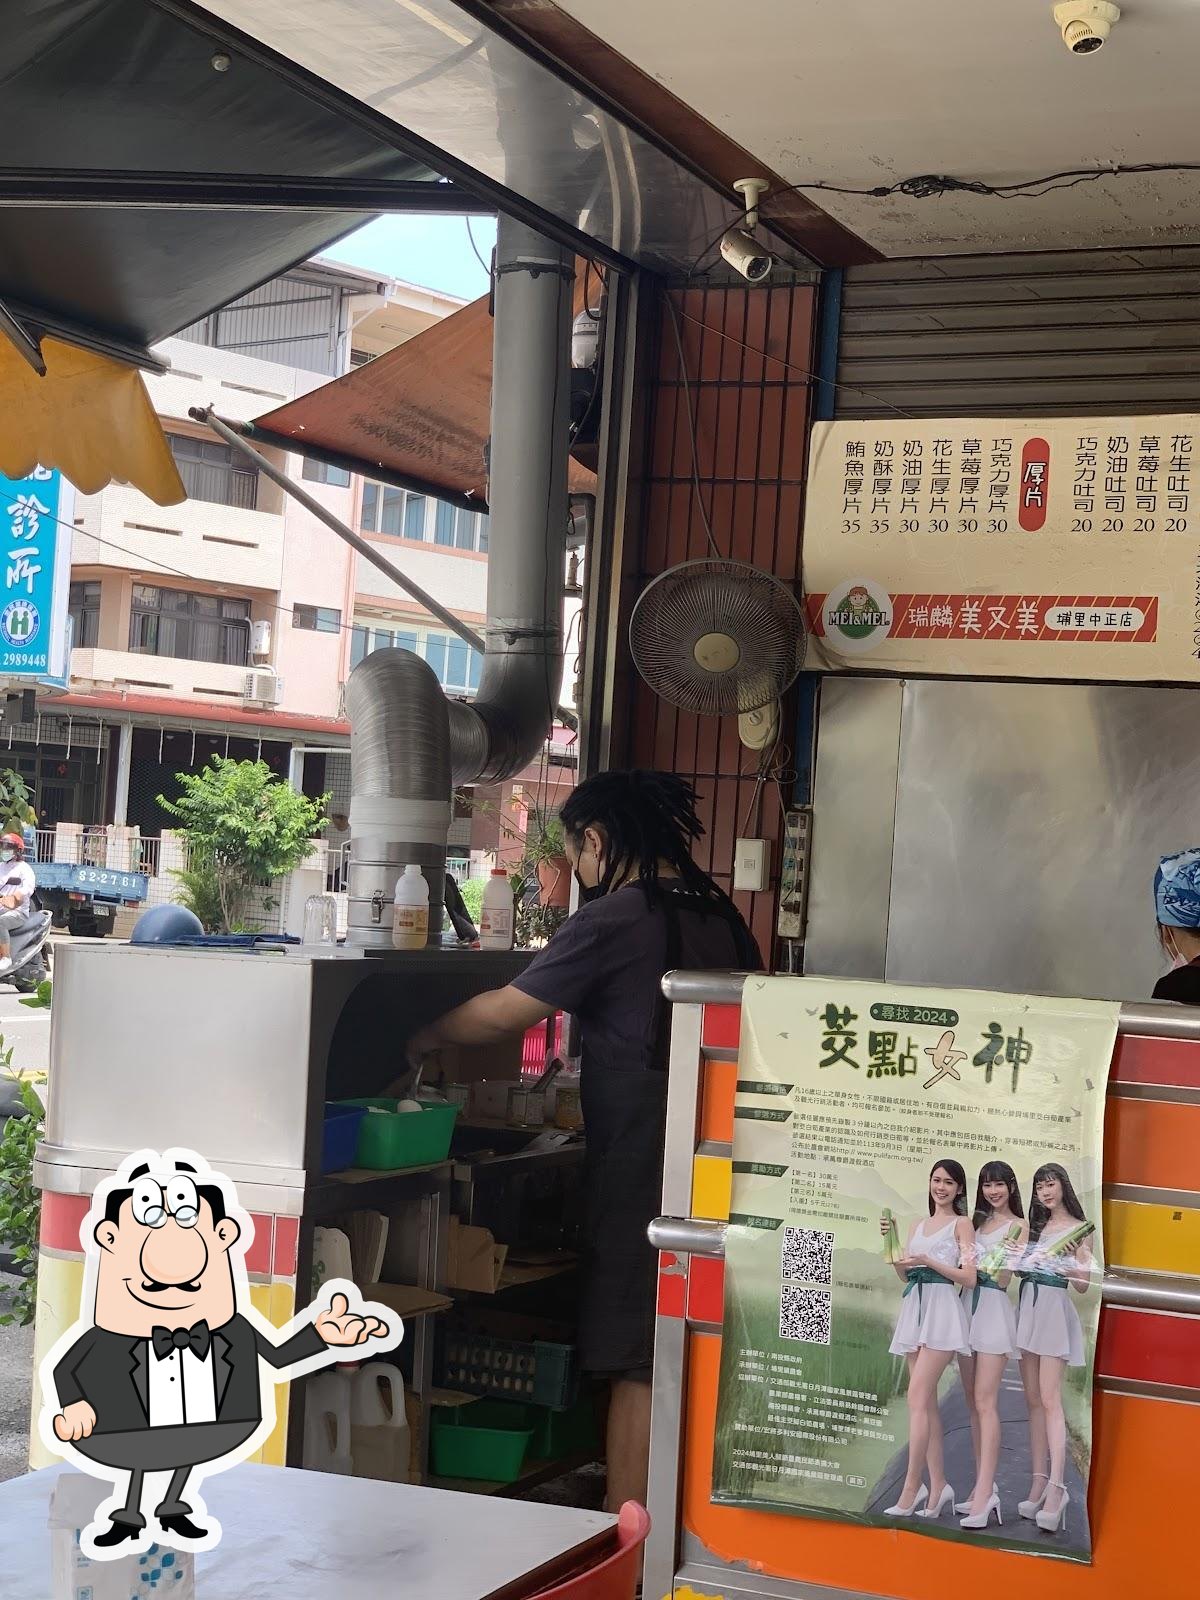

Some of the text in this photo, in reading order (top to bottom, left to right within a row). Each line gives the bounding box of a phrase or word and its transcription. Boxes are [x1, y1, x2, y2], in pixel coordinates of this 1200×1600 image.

[841, 440, 865, 534] 鮪魚厚片 35
[869, 440, 894, 534] 奶酥厚片 35
[898, 440, 922, 533] 奶油厚片 30
[927, 439, 952, 533] 花生厚片 30
[957, 439, 982, 533] 草莓厚片 30
[986, 438, 1012, 533] 巧克力厚片 30
[1024, 462, 1047, 508] 厚片
[1071, 437, 1098, 532] 巧克力吐司 20
[1102, 436, 1129, 532] 奶油吐司 20
[1133, 435, 1160, 532] 草莓吐司 20
[1164, 435, 1192, 532] 花生吐司 20
[3, 652, 46, 667] 2989448
[1056, 612, 1133, 627] 埔里中正店
[818, 1003, 1034, 1094] 茭點女神
[881, 1005, 948, 1024] 尋找 2024
